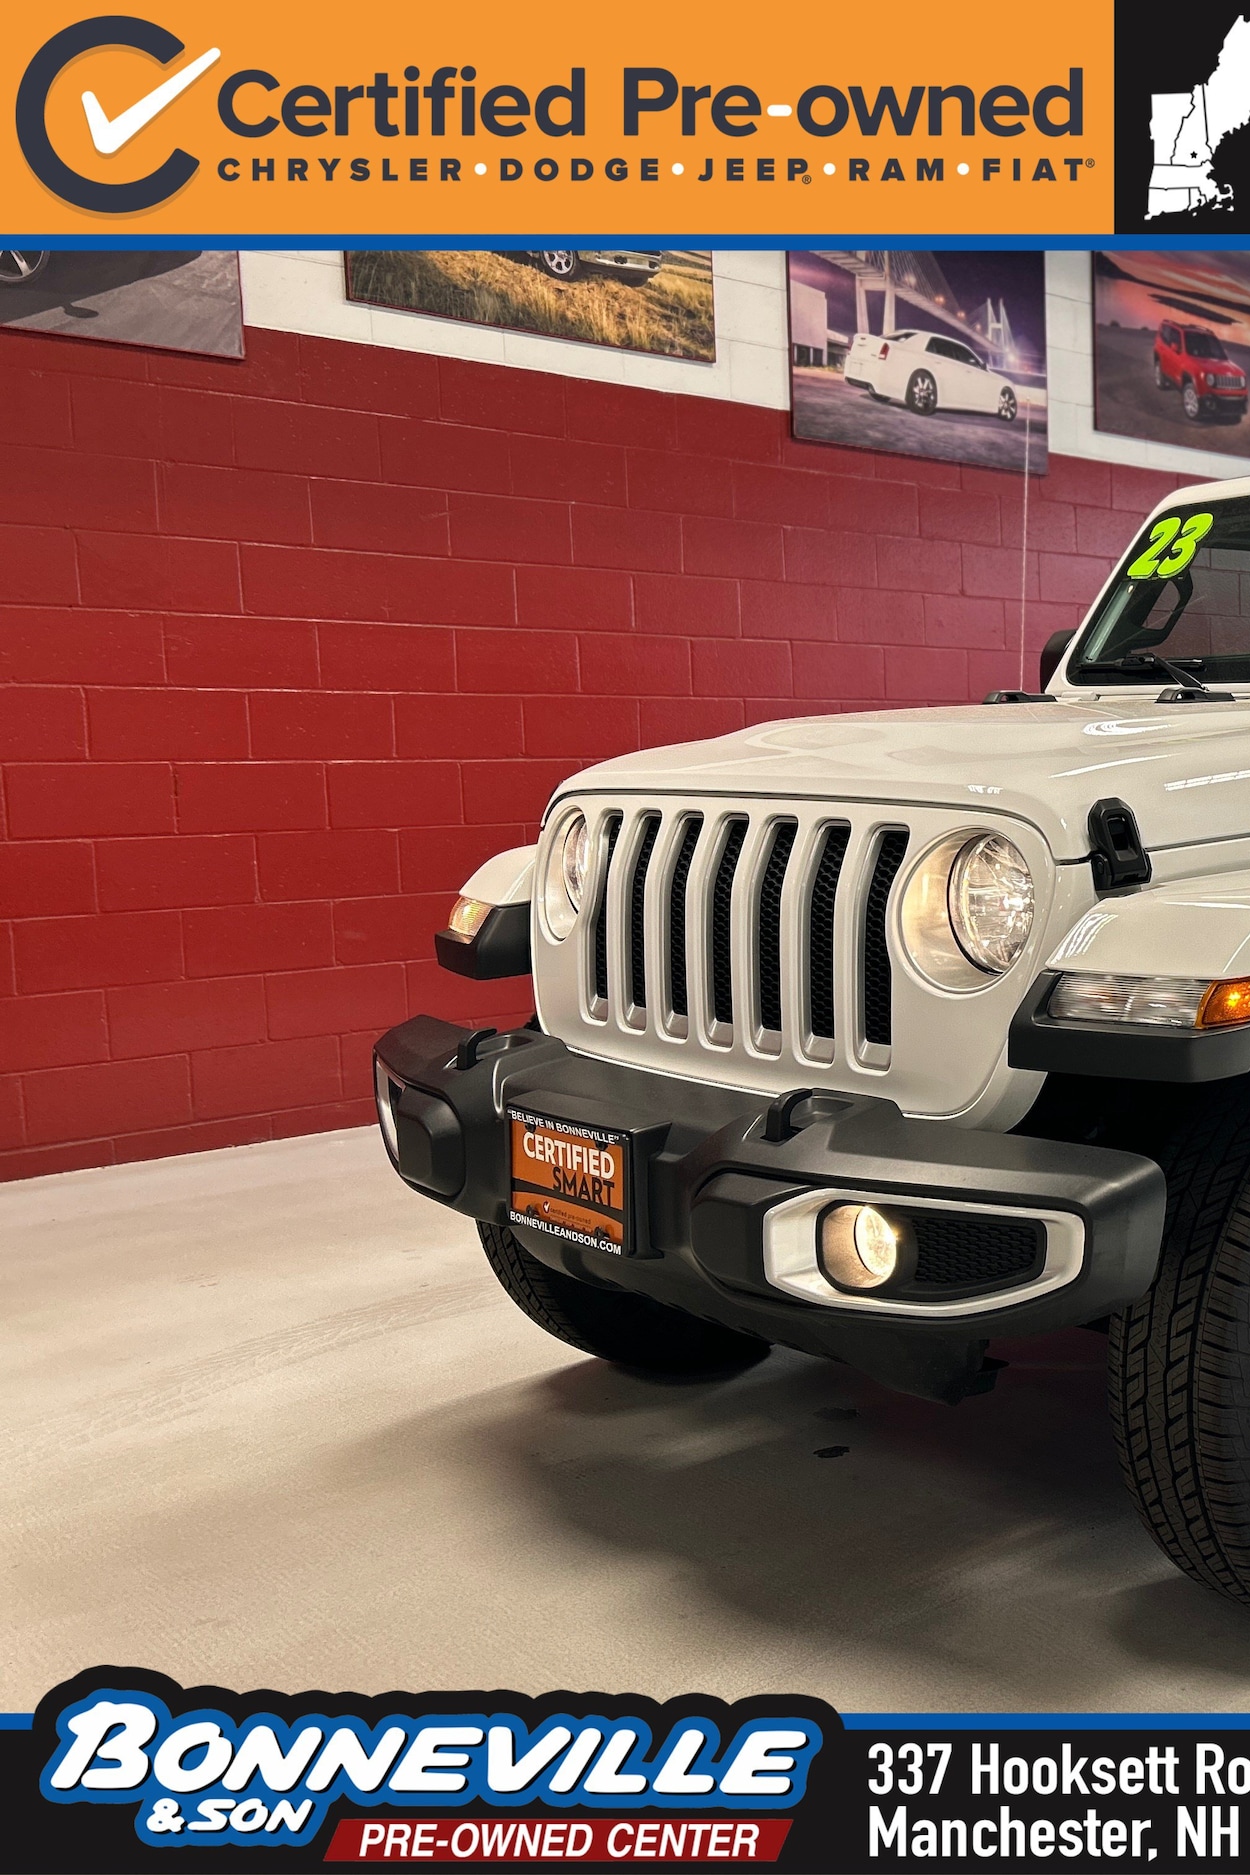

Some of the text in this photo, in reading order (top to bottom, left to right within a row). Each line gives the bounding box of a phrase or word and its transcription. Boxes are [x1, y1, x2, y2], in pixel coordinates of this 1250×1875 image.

[1127, 512, 1213, 579] 23
[545, 1119, 554, 1130] IN
[523, 1132, 615, 1179] CERTIFIED
[552, 1166, 615, 1208] SMART
[510, 1211, 622, 1255] BONNEVILLEANDSON.COM
